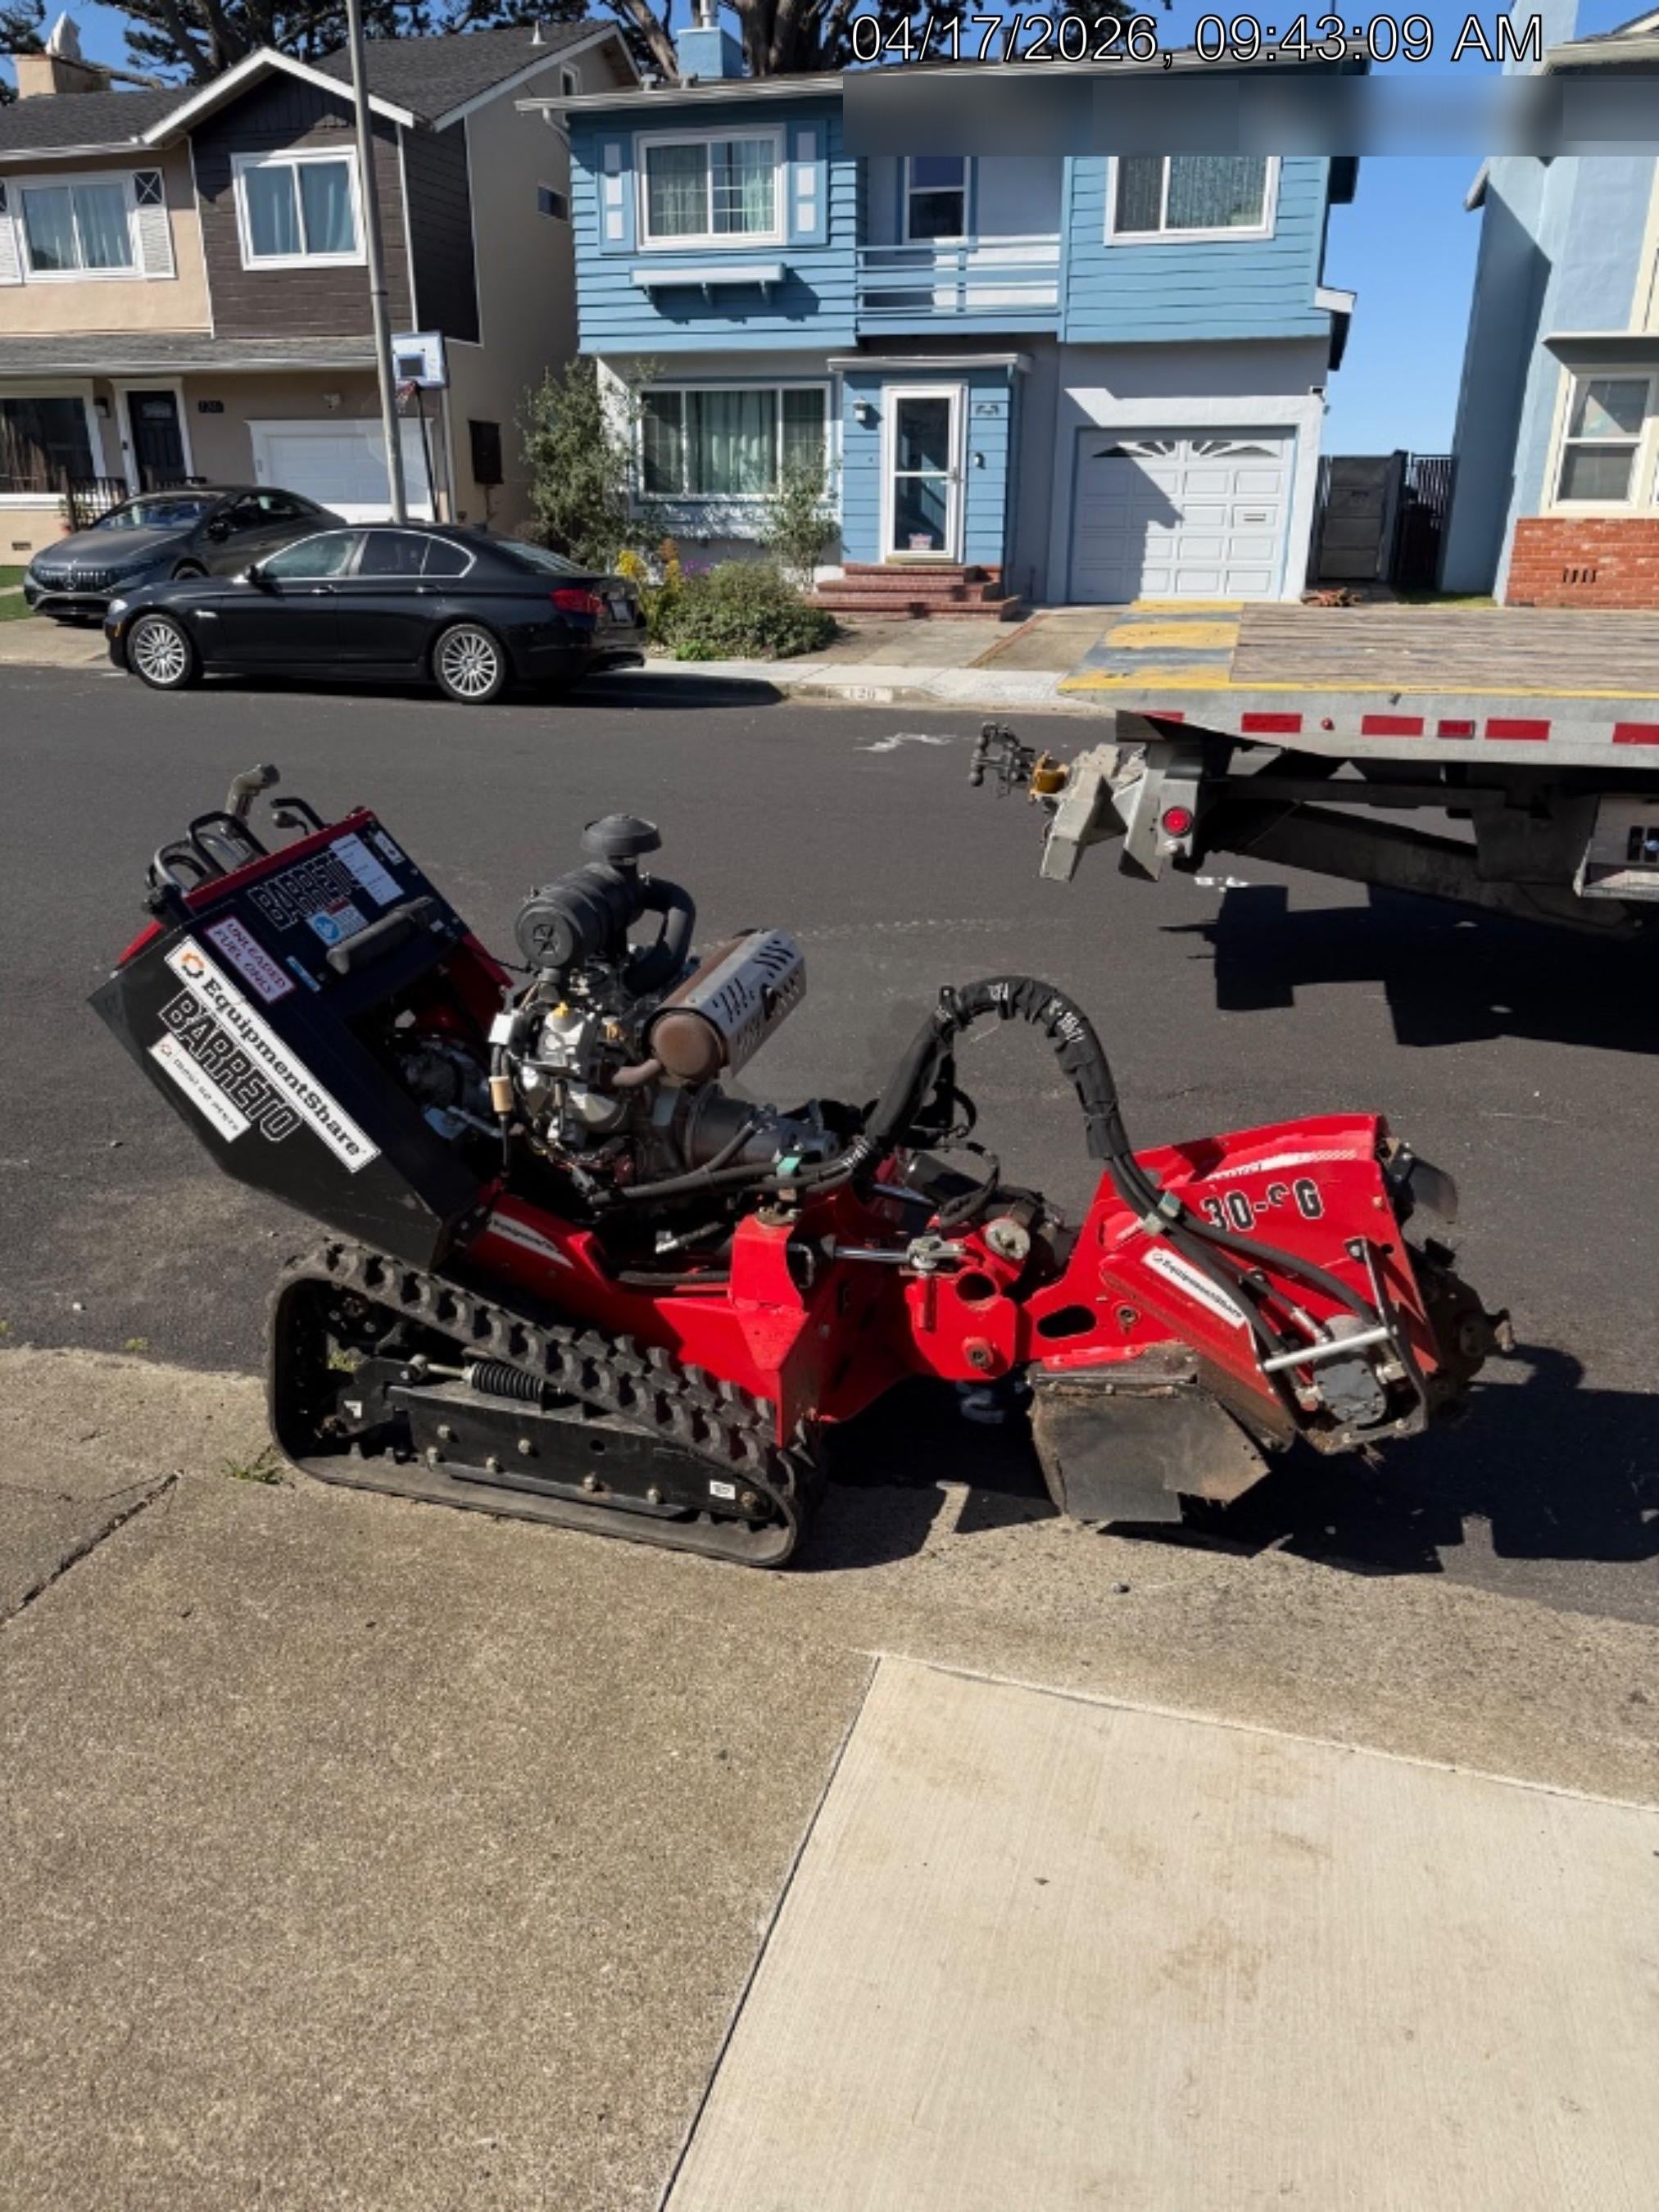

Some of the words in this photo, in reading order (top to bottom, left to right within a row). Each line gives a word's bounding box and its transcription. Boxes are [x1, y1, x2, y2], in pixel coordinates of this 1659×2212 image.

[212, 927, 246, 961] FUEL
[242, 959, 274, 995] ONLY
[225, 922, 287, 990] UNLEADED
[157, 988, 304, 1145] BARRETO
[201, 976, 362, 1157] EquipmentShare
